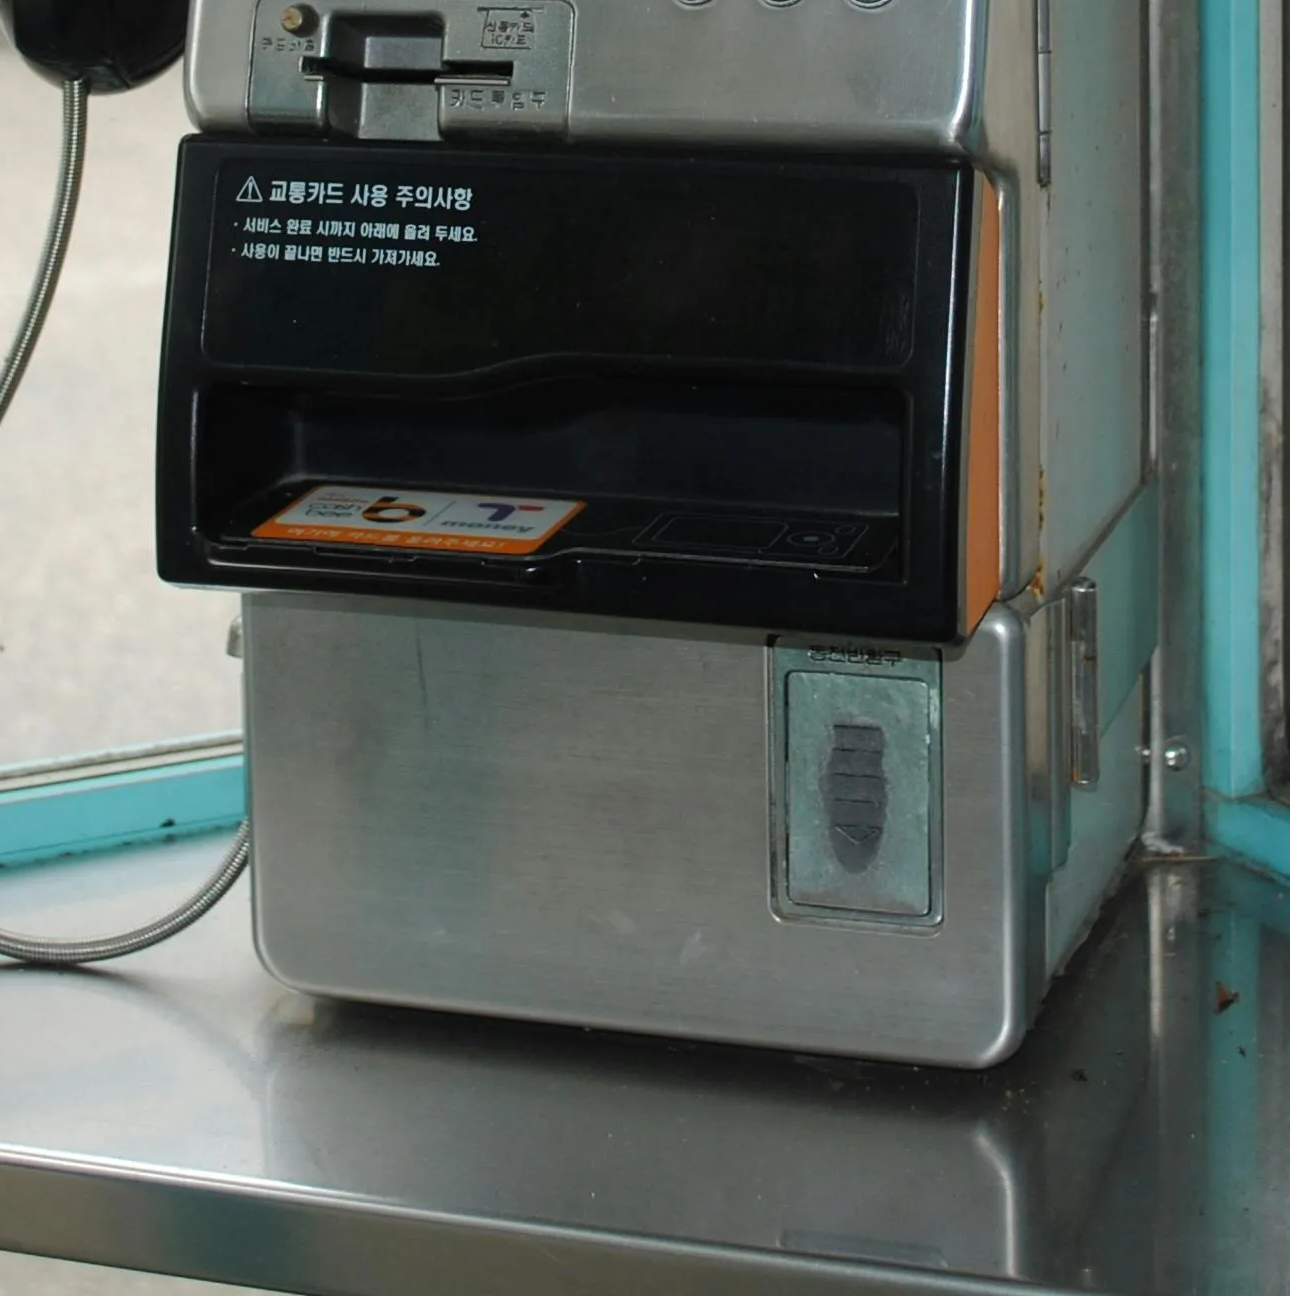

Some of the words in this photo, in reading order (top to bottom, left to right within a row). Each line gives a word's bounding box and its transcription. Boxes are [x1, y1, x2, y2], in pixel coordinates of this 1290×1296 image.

[269, 180, 345, 205] 교통카드
[351, 183, 388, 207] 사용
[395, 185, 473, 211] 주의사항
[243, 217, 282, 234] 서비스
[286, 218, 312, 236] 완료
[316, 220, 356, 237] 시까지
[360, 222, 399, 240] 아래에
[404, 224, 430, 241] 올려
[435, 225, 478, 243] 두세요.
[241, 242, 280, 260] 사용이
[284, 244, 323, 262] 끝나면
[327, 246, 366, 264] 반드시
[371, 248, 440, 267] 가져가세요.
